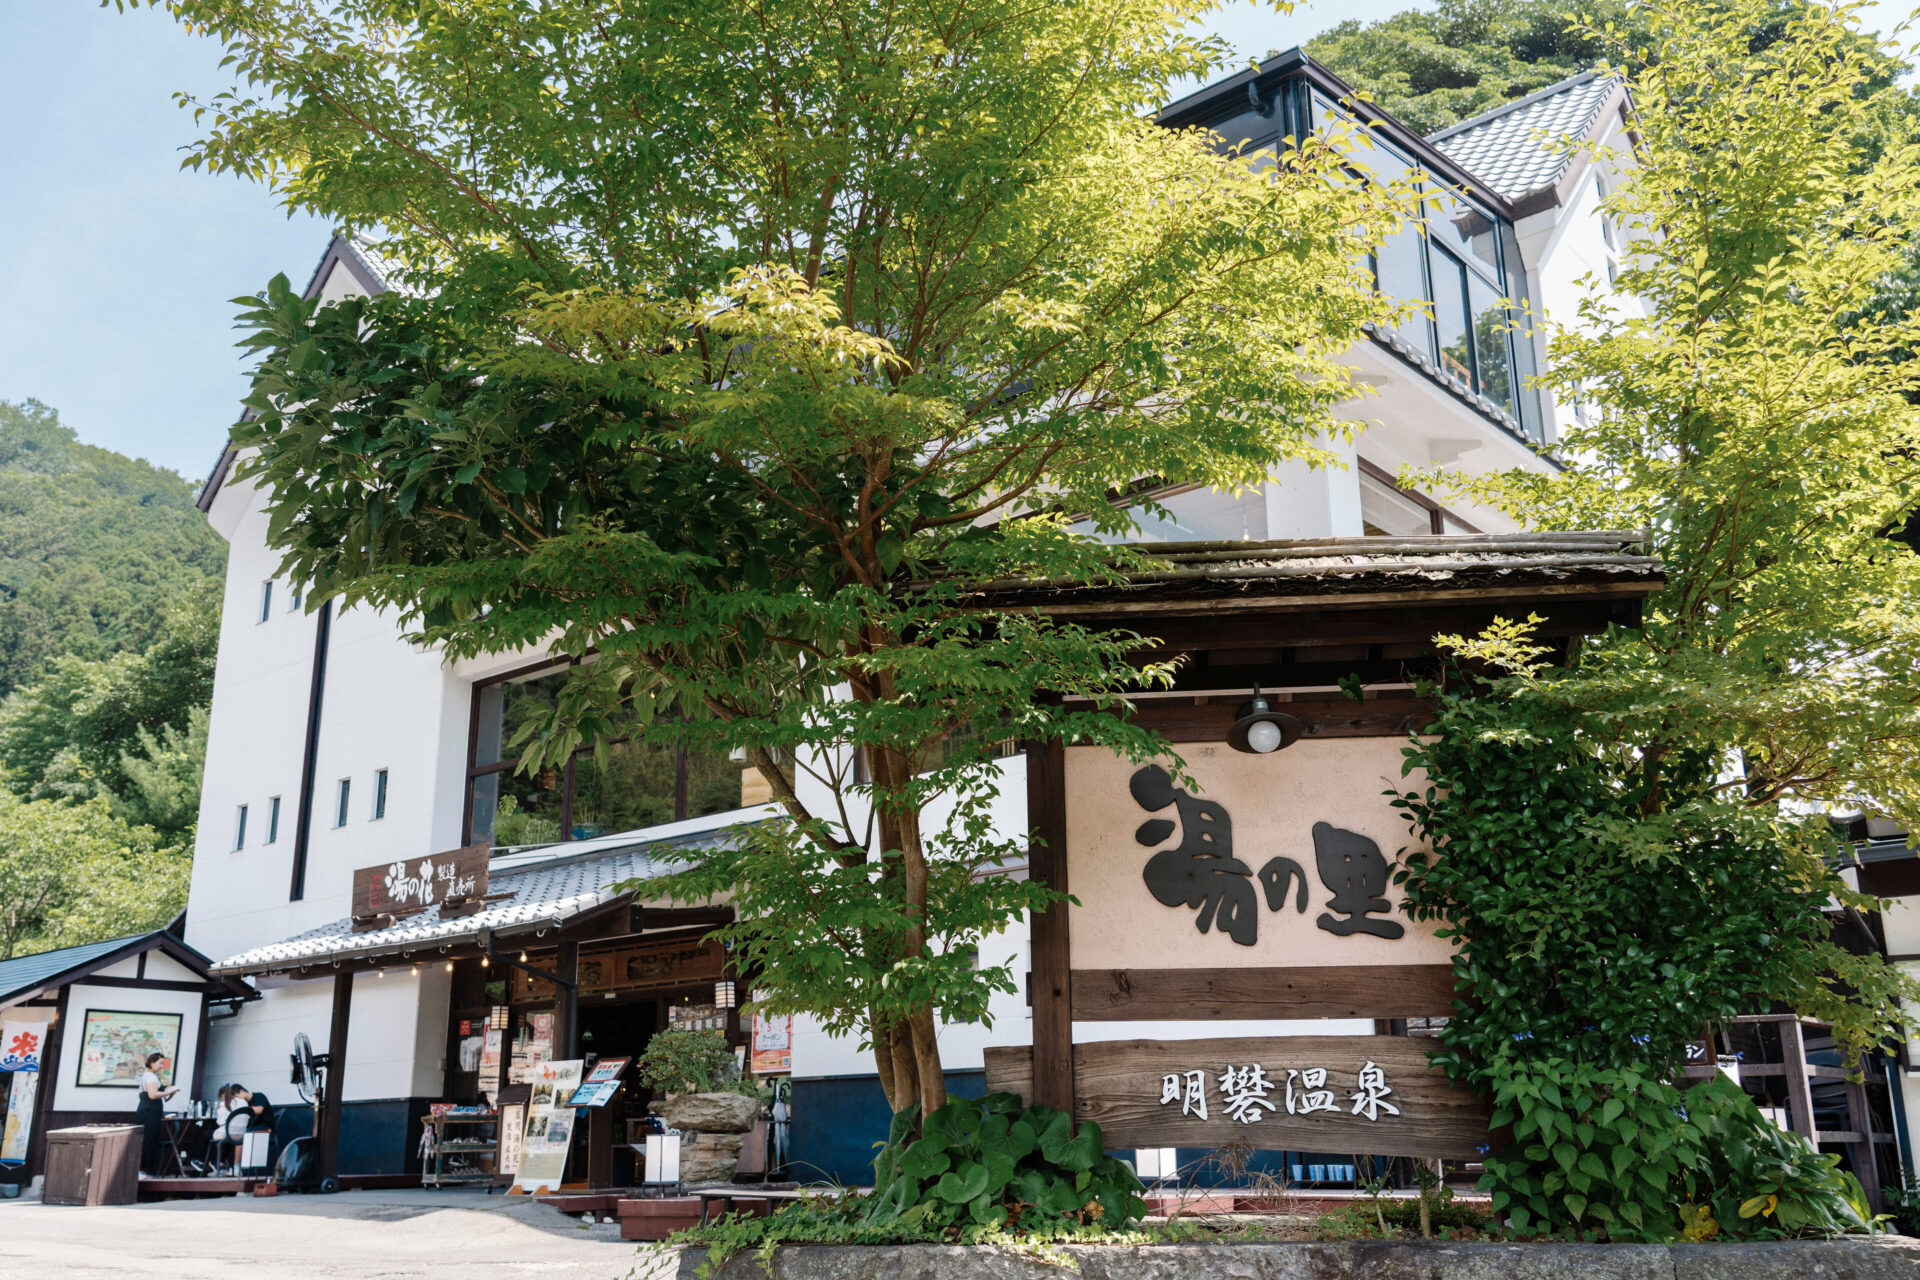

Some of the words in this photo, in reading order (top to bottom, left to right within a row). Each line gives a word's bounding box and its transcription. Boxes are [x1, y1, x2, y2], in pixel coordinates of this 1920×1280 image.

[437, 861, 456, 881] 製造
[1129, 764, 1404, 946] 湯の里
[384, 859, 434, 905] 湯の花
[445, 875, 476, 897] 直売所
[8, 1031, 39, 1057] 氷
[1160, 1061, 1400, 1124] 明礬温泉
